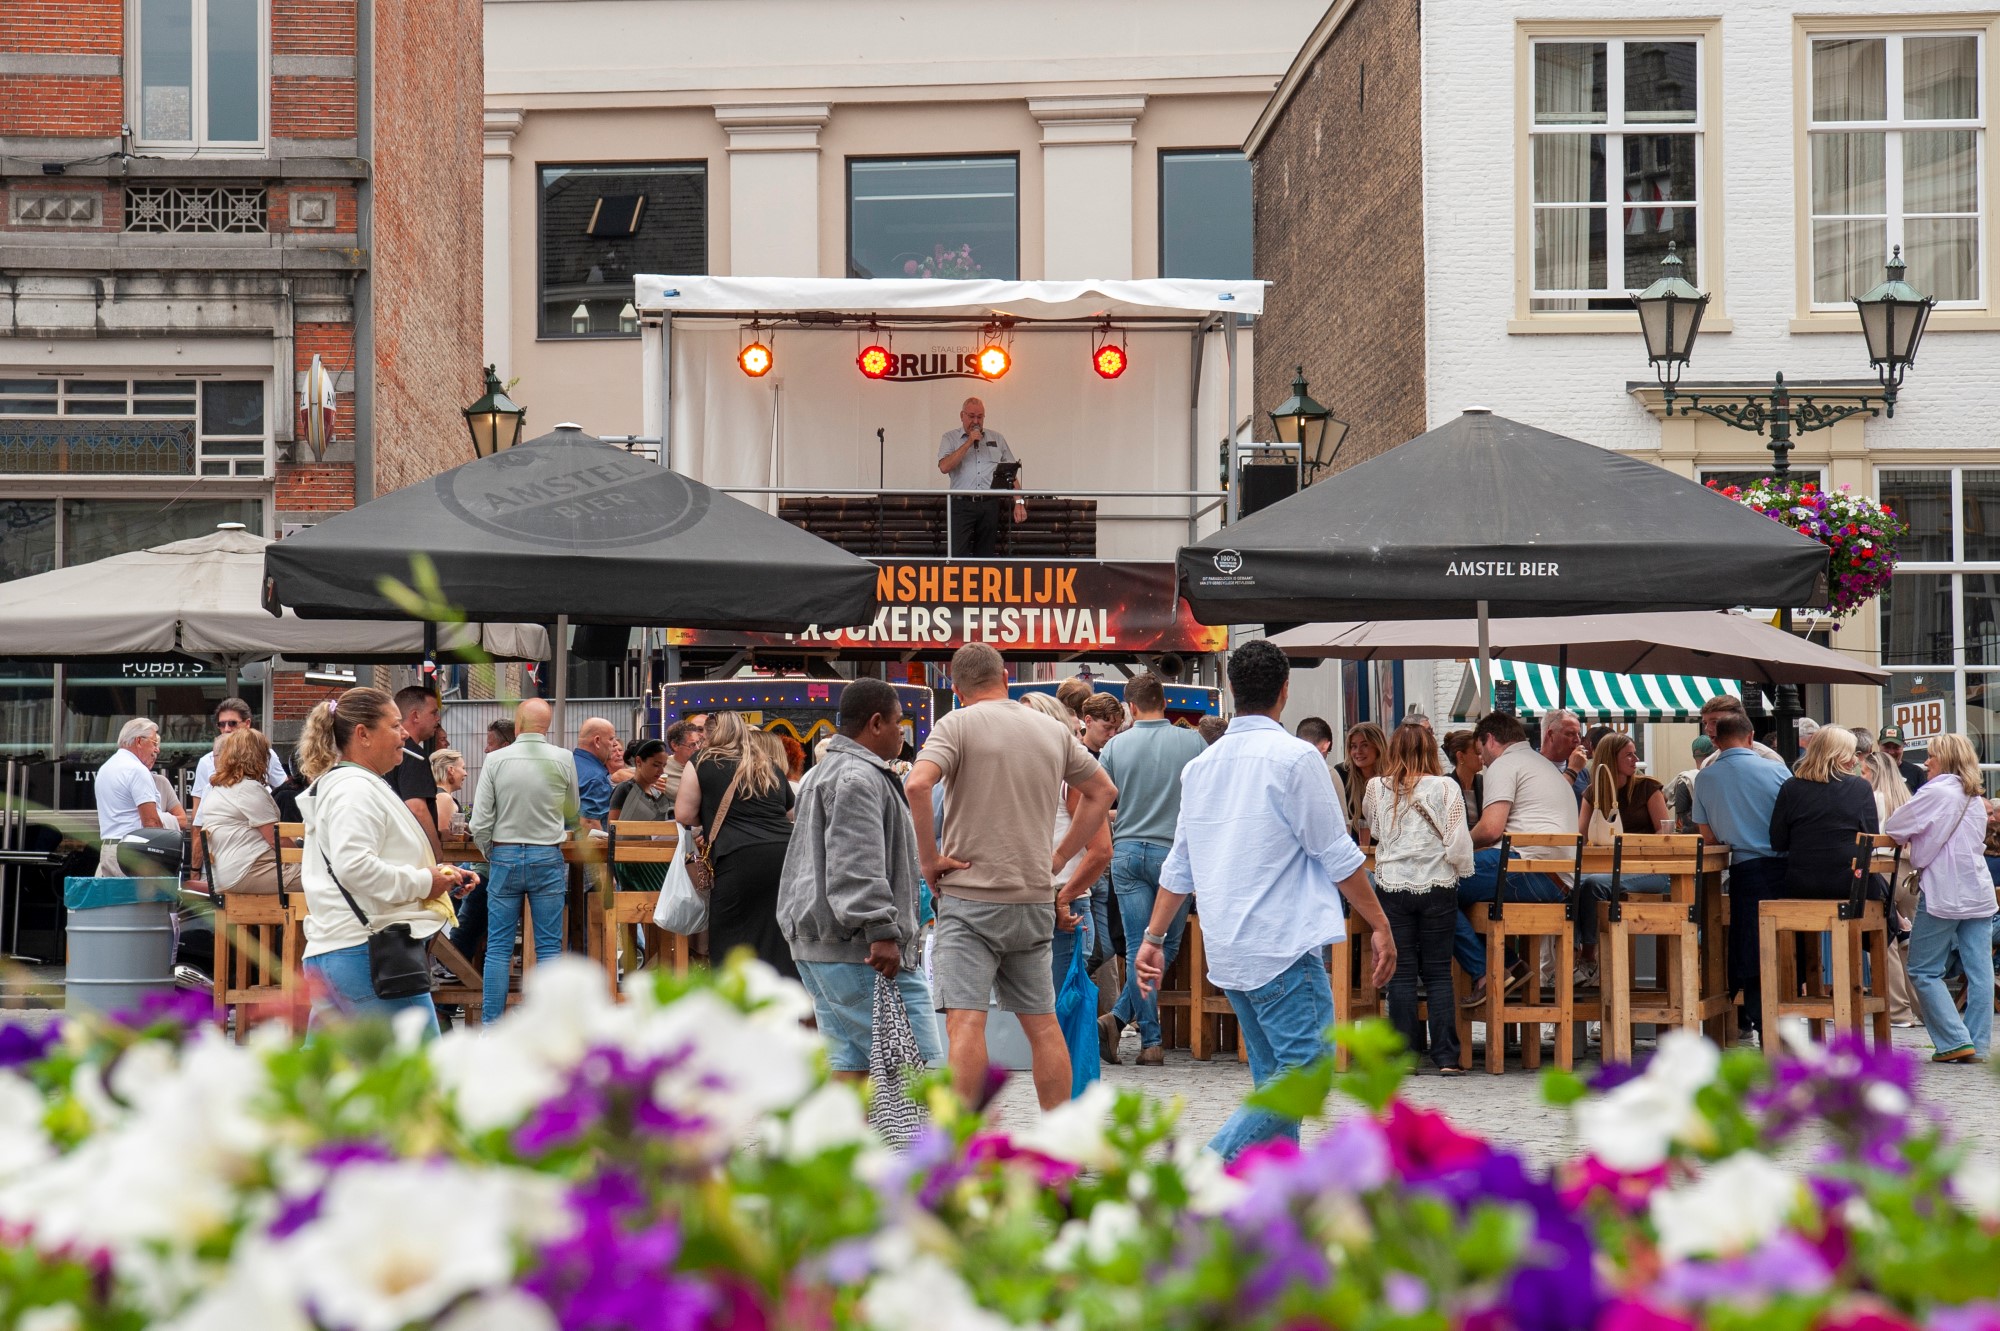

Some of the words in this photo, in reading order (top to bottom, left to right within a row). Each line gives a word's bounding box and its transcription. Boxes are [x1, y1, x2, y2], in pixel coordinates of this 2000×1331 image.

[481, 461, 647, 512] AMSTEL
[553, 492, 635, 519] BIER
[876, 565, 1078, 604] NSHEERLIJK
[1445, 561, 1516, 576] AMSTEL
[1519, 562, 1560, 576] BIER
[785, 606, 952, 642] KERS
[963, 607, 1115, 645] FESTIVAL
[122, 662, 204, 673] PUBBYS
[1896, 702, 1942, 737] PHB
